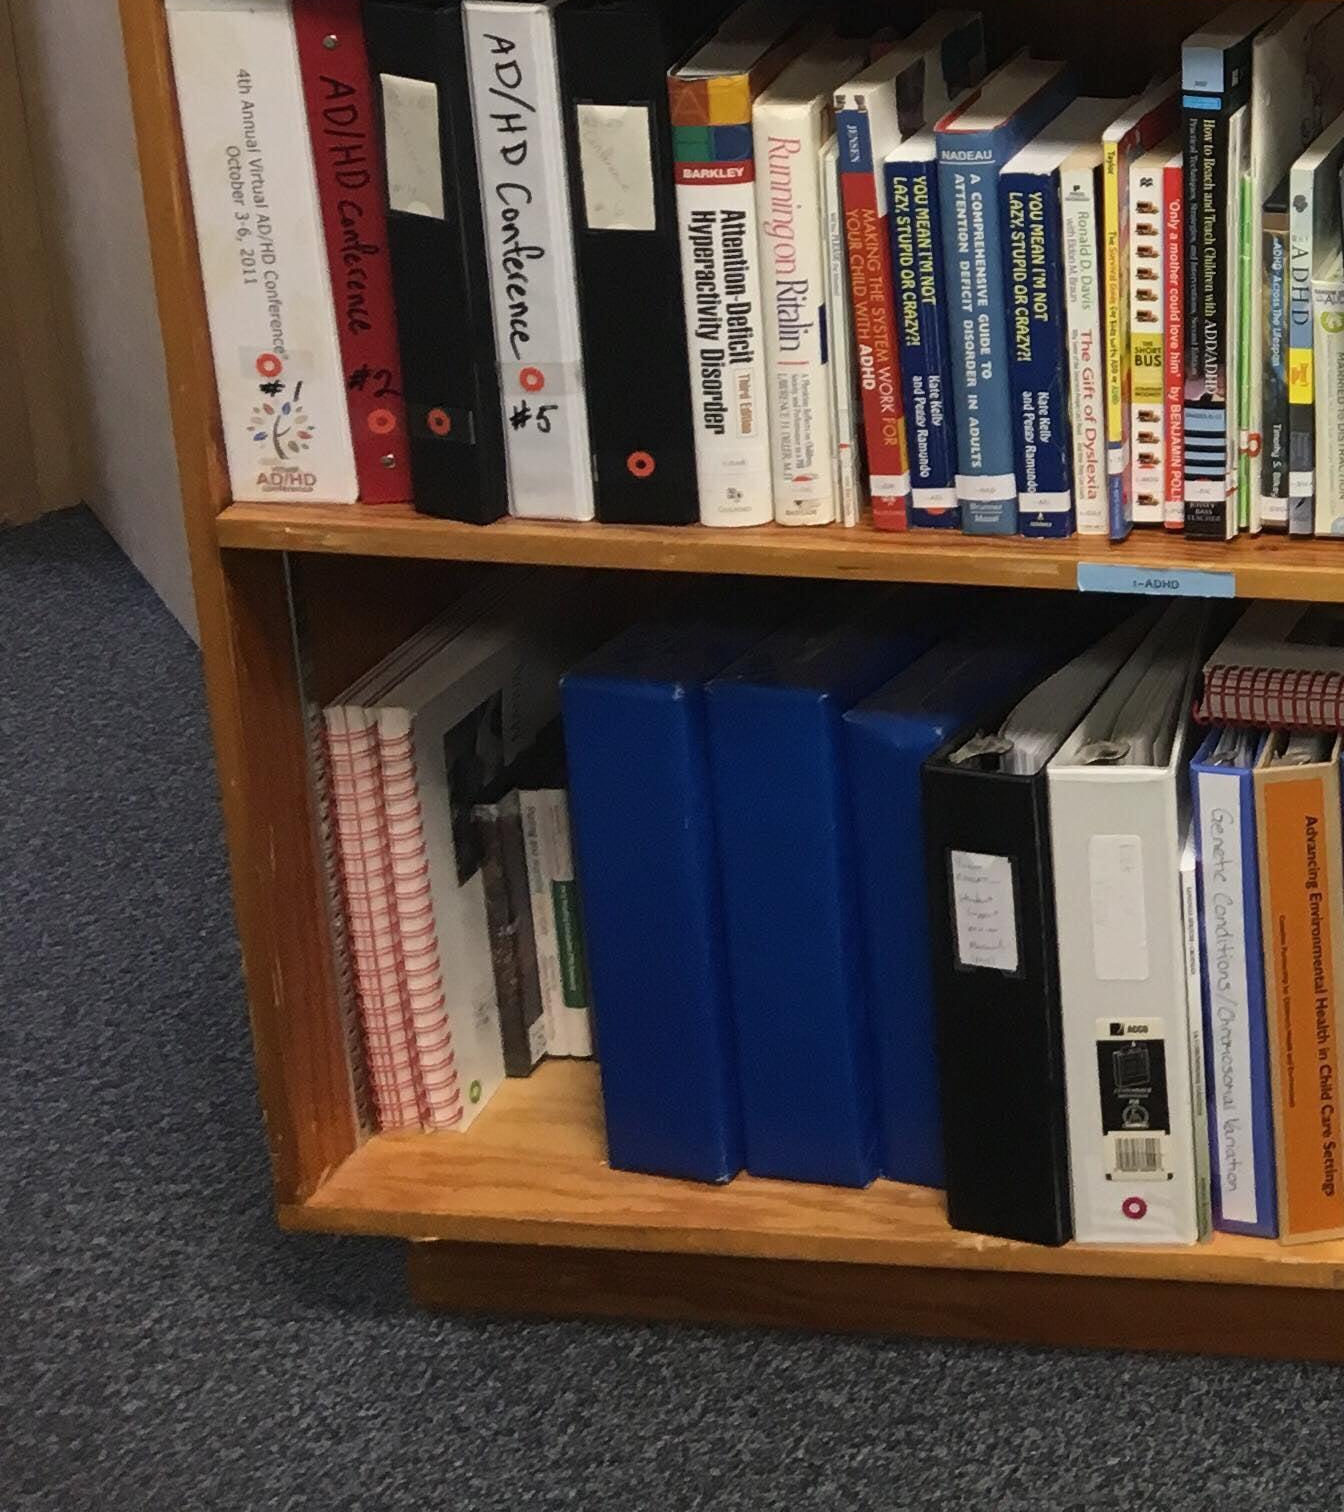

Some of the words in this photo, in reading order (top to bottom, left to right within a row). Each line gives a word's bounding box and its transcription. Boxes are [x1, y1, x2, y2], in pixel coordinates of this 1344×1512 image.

[683, 167, 744, 178] BARKLEY
[942, 150, 992, 160] NADEAU
[496, 183, 545, 360] Conference
[689, 210, 723, 342] Hyperactivity
[720, 209, 754, 364] Attention-Deficit
[700, 348, 726, 436] Disorder
